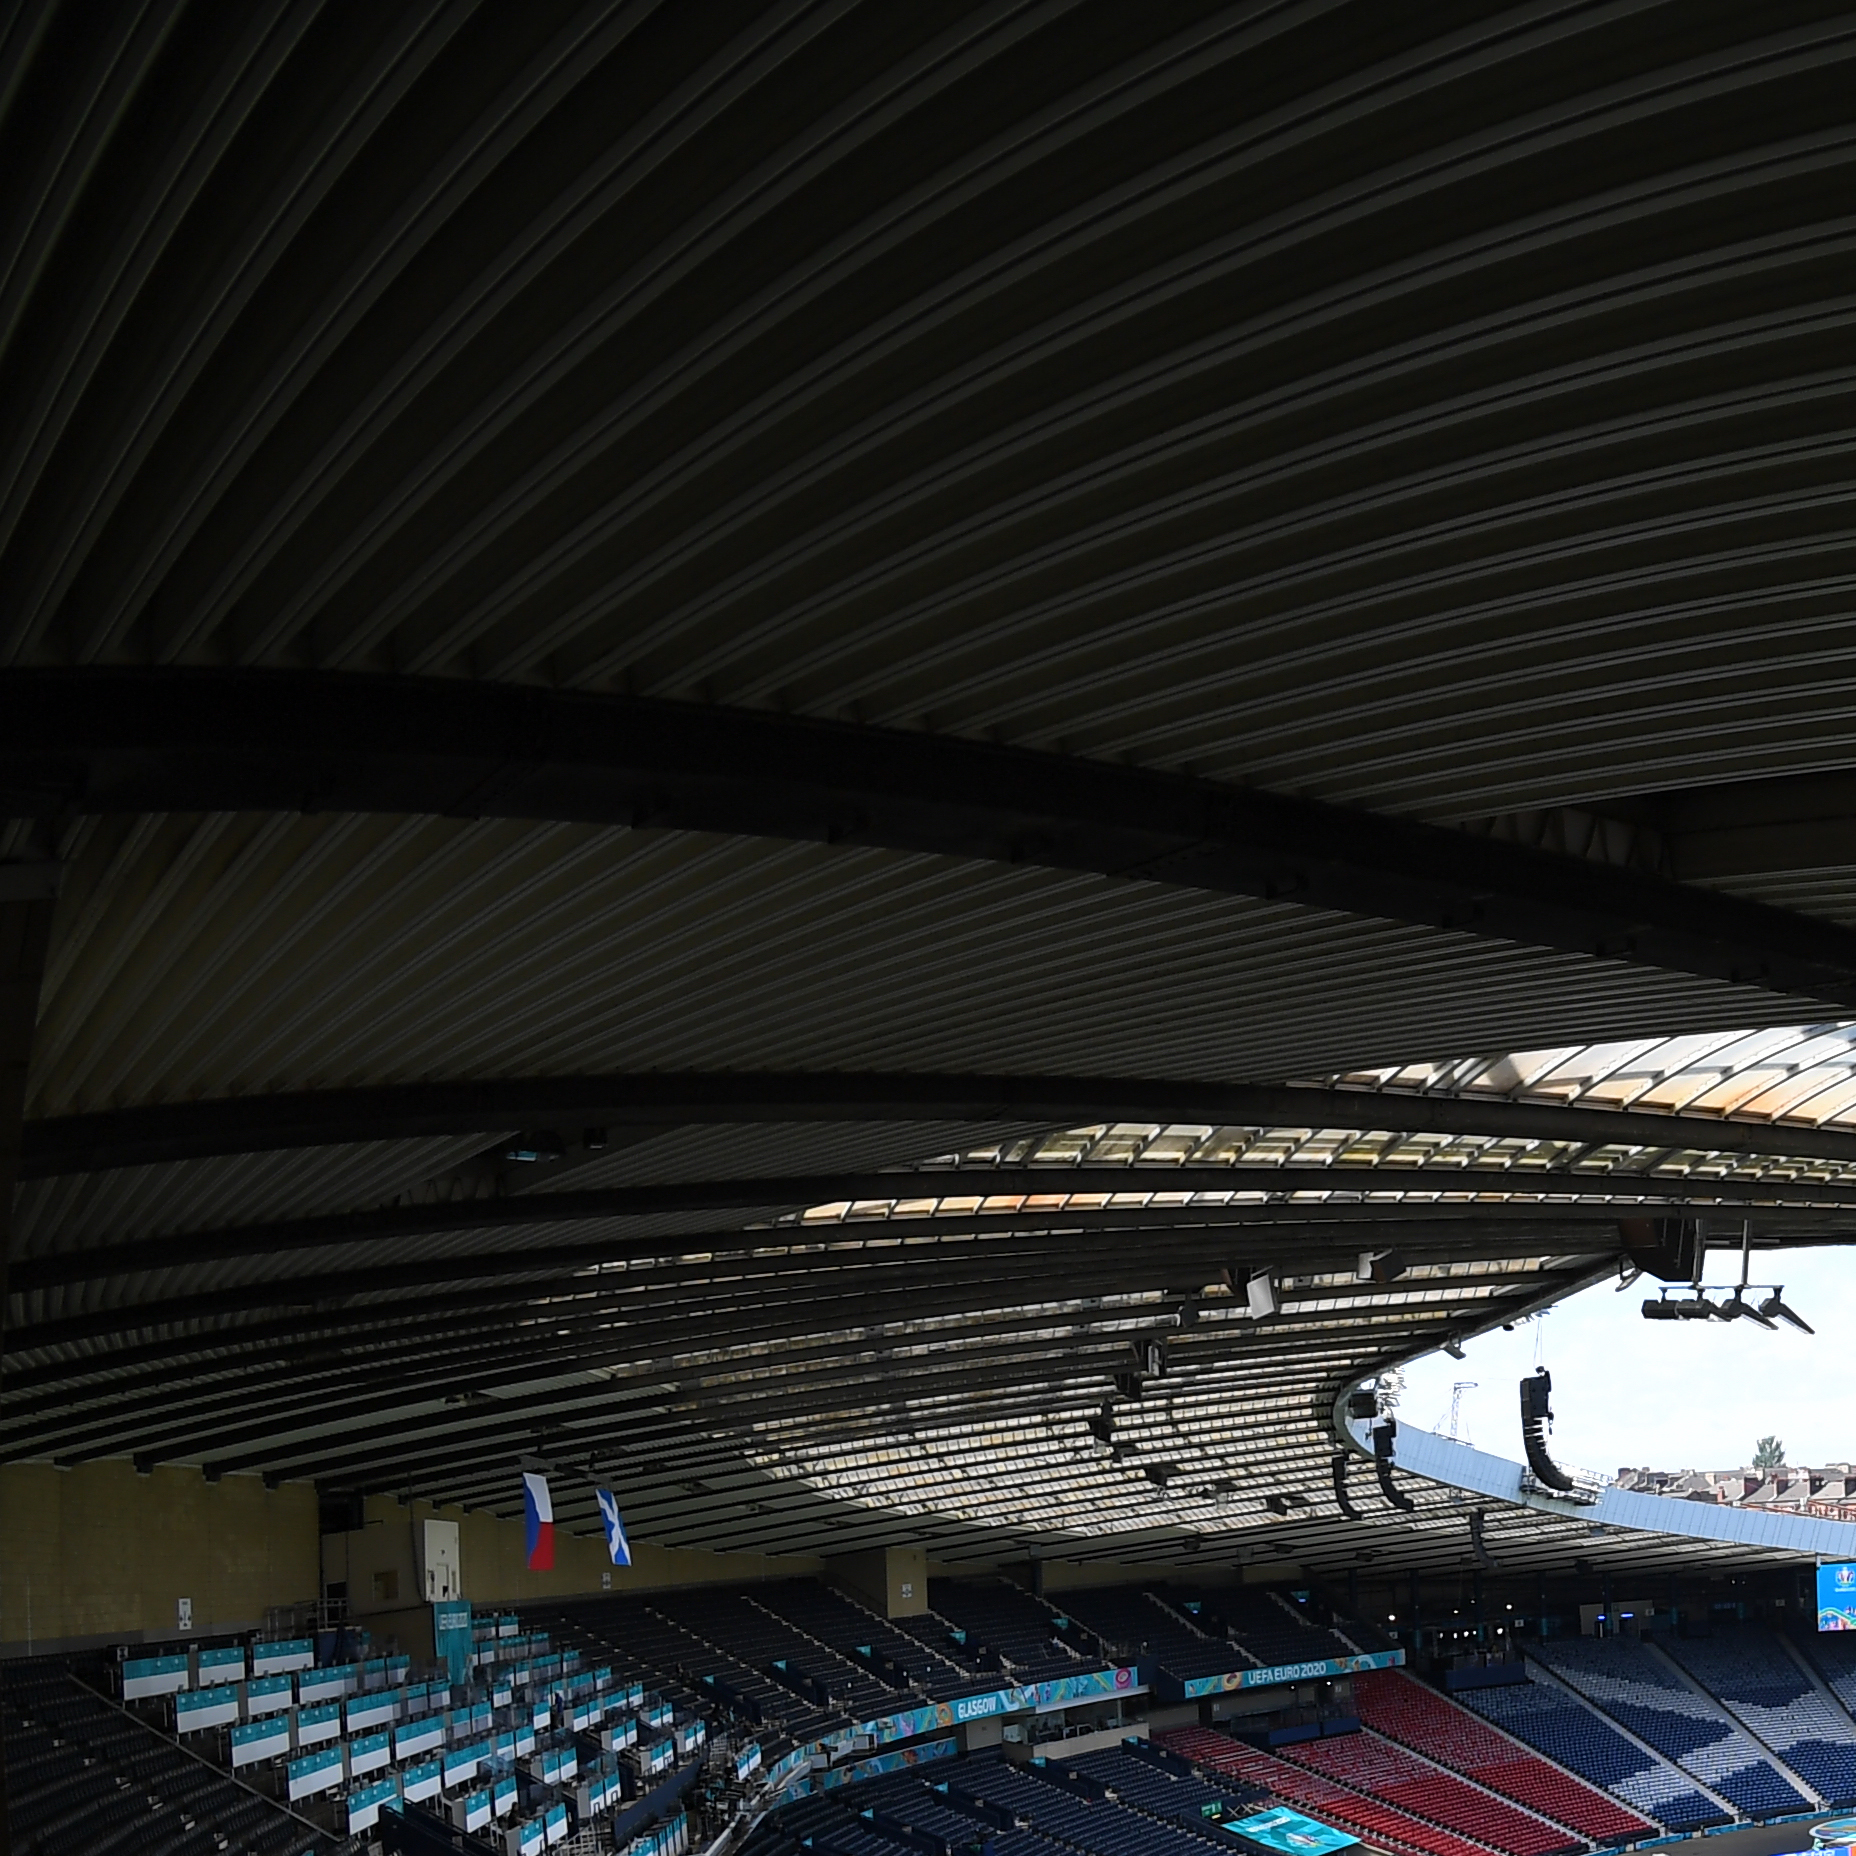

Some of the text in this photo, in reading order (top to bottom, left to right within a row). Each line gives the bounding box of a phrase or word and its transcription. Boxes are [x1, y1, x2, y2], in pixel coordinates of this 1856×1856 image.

[1248, 1661, 1327, 1685] UEFA EURO 2020
[958, 1696, 997, 1720] GLASGOW
